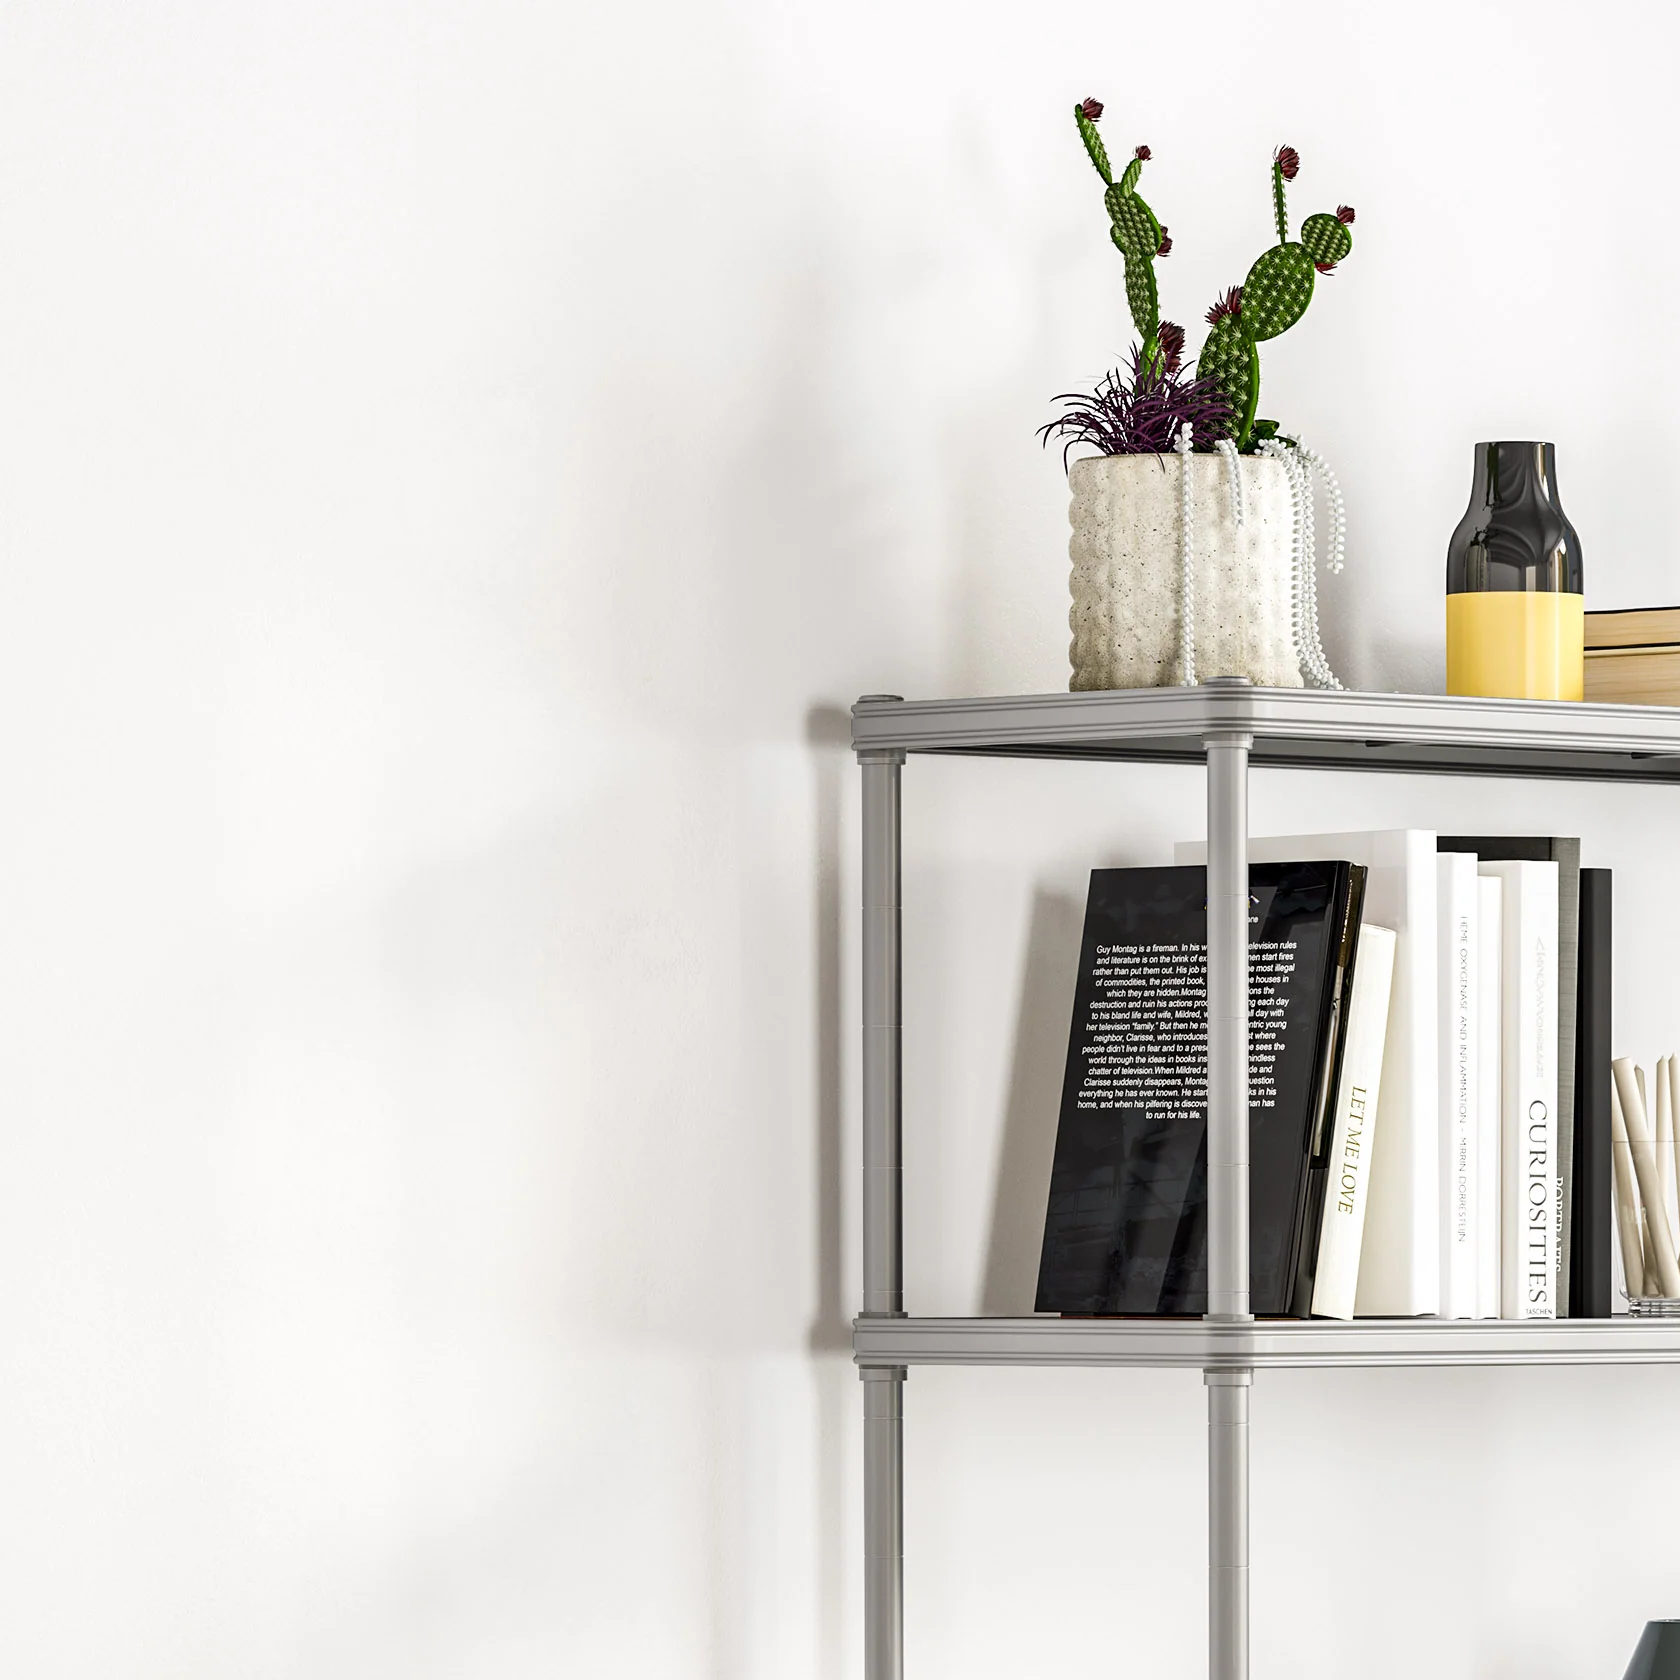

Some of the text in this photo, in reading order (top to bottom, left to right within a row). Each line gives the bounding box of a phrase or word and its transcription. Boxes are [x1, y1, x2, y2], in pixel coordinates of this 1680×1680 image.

[1459, 916, 1469, 944] HEME
[1096, 944, 1111, 955] Guy
[1112, 944, 1137, 954] Montag
[1139, 944, 1145, 952] is
[1152, 943, 1179, 952] fireman.
[1181, 943, 1188, 951] In
[1189, 943, 1200, 951] his
[1279, 941, 1297, 950] rules
[1097, 955, 1110, 964] and
[1111, 955, 1140, 963] literature
[1142, 955, 1148, 963] is
[1159, 954, 1170, 963] the
[1172, 954, 1189, 962] brink
[1190, 954, 1197, 962] of
[1261, 953, 1277, 961] start
[1278, 952, 1293, 961] fires
[1093, 964, 1295, 976] rather than put them out. His job is most illegal
[1095, 974, 1289, 987] of commodities, the printed book, houses in
[1459, 948, 1469, 1010] OXYGENASE
[1106, 988, 1126, 997] which
[1127, 988, 1142, 999] they
[1263, 986, 1274, 994] the
[1090, 1000, 1127, 1008] destruction
[1128, 999, 1141, 1008] and
[1142, 999, 1155, 1007] ruin
[1156, 999, 1167, 1007] his
[1168, 999, 1193, 1007] actions
[1257, 997, 1275, 1006] each
[1275, 997, 1289, 1008] day
[1091, 1011, 1098, 1019] to
[1100, 1011, 1110, 1019] his
[1111, 1010, 1130, 1019] bland
[1131, 1010, 1141, 1019] life
[1143, 1010, 1156, 1018] and
[1157, 1010, 1173, 1020] wife,
[1175, 1009, 1202, 1020] Mildred,
[1255, 1008, 1268, 1019] day
[1269, 1008, 1284, 1017] with
[1086, 1022, 1097, 1030] her
[1099, 1022, 1130, 1030] television
[1159, 1021, 1172, 1029] But
[1172, 1021, 1188, 1029] then
[1189, 1020, 1198, 1029] he
[1265, 1022, 1287, 1030] young
[1459, 1016, 1468, 1040] AND
[1093, 1033, 1125, 1043] neighbor,
[1126, 1032, 1155, 1043] Clarisse,
[1156, 1032, 1171, 1040] who
[1254, 1031, 1276, 1039] where
[1082, 1044, 1105, 1055] people
[1126, 1044, 1138, 1052] live
[1139, 1043, 1146, 1052] in
[1147, 1043, 1160, 1052] fear
[1162, 1043, 1175, 1051] and
[1176, 1043, 1183, 1051] to
[1273, 1041, 1285, 1050] the
[1088, 1055, 1106, 1064] world
[1108, 1055, 1134, 1065] through
[1135, 1055, 1146, 1063] the
[1147, 1054, 1166, 1063] ideas
[1167, 1054, 1174, 1063] in
[1175, 1054, 1196, 1062] books
[1088, 1066, 1111, 1075] chatter
[1113, 1066, 1120, 1074] of
[1176, 1065, 1201, 1073] Mildred
[1259, 1064, 1272, 1072] and
[1083, 1077, 1183, 1088] Clarisse suddenly disappears,
[1459, 1044, 1468, 1124] INFLAMMATION
[1078, 1089, 1113, 1099] everything
[1115, 1088, 1124, 1097] he
[1125, 1088, 1138, 1096] has
[1155, 1088, 1179, 1096] known.
[1181, 1087, 1192, 1096] He
[1258, 1086, 1265, 1095] in
[1266, 1086, 1277, 1094] his
[1077, 1100, 1098, 1110] home,
[1100, 1100, 1113, 1108] and
[1114, 1099, 1133, 1108] when
[1134, 1099, 1144, 1108] his
[1145, 1099, 1172, 1109] pilfering
[1174, 1099, 1180, 1107] is
[1262, 1097, 1275, 1106] has
[1145, 1110, 1153, 1119] to
[1167, 1110, 1176, 1118] for
[1177, 1110, 1188, 1118] his
[1189, 1110, 1201, 1118] life.
[1338, 1086, 1367, 1215] LET ME LOVE
[1528, 1100, 1548, 1303] CURIOSITIES
